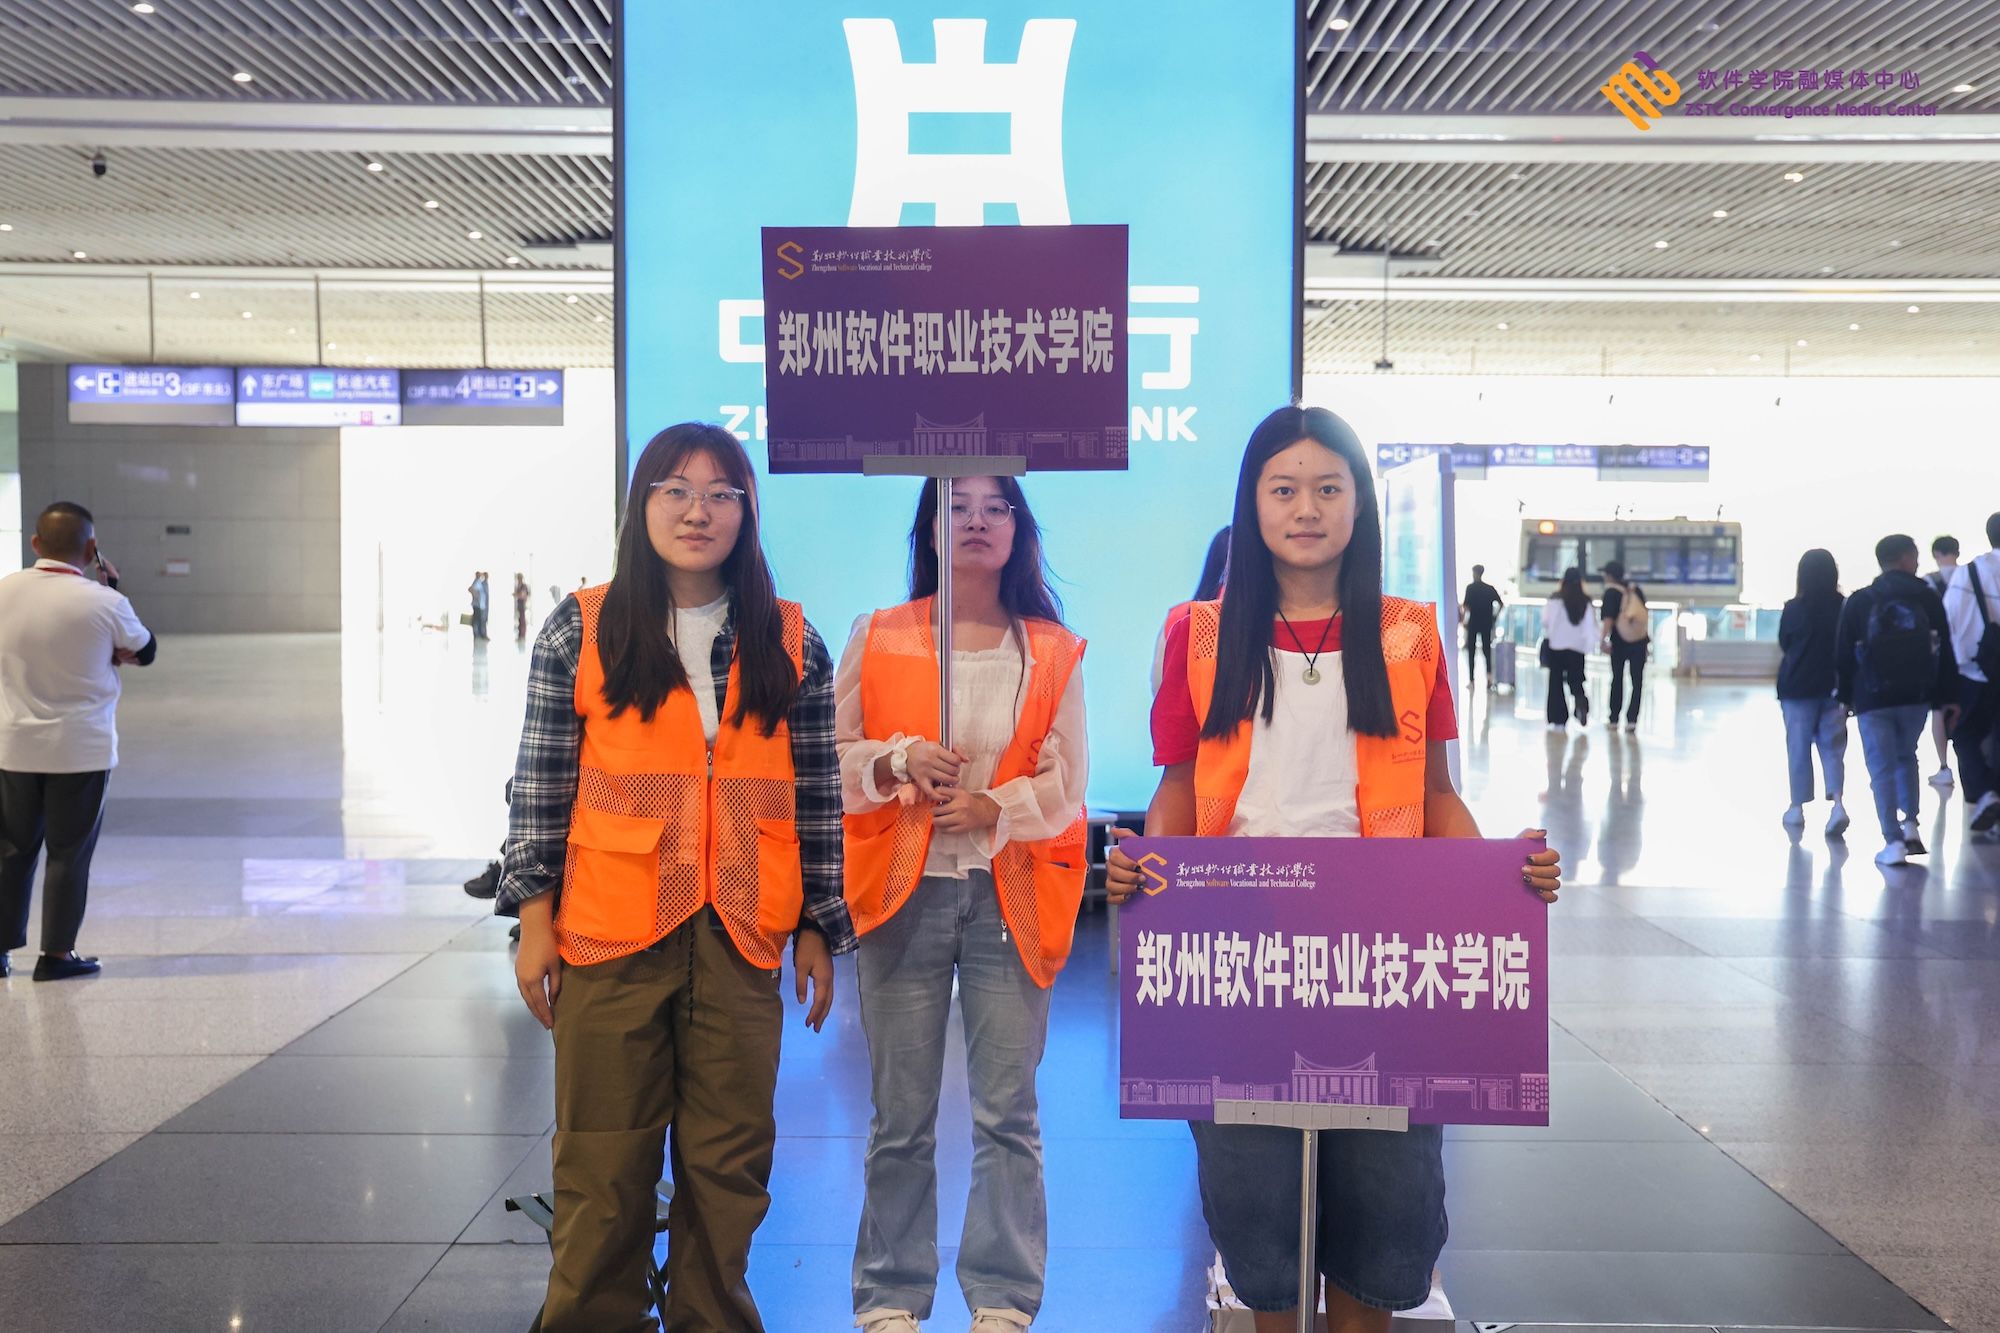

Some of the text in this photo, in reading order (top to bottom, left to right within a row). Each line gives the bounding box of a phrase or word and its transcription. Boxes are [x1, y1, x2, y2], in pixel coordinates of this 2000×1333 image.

[858, 263, 882, 271] Vocational
[883, 263, 892, 271] and
[778, 307, 1113, 376] 郑州软件职业技术学院
[165, 372, 181, 397] 3
[455, 375, 471, 398] 4
[1131, 406, 1198, 442] NK
[1176, 879, 1316, 889] Zhengzhou Software Vocational and Technical College
[1135, 929, 1530, 1010] 郑州软件职业技术学院
